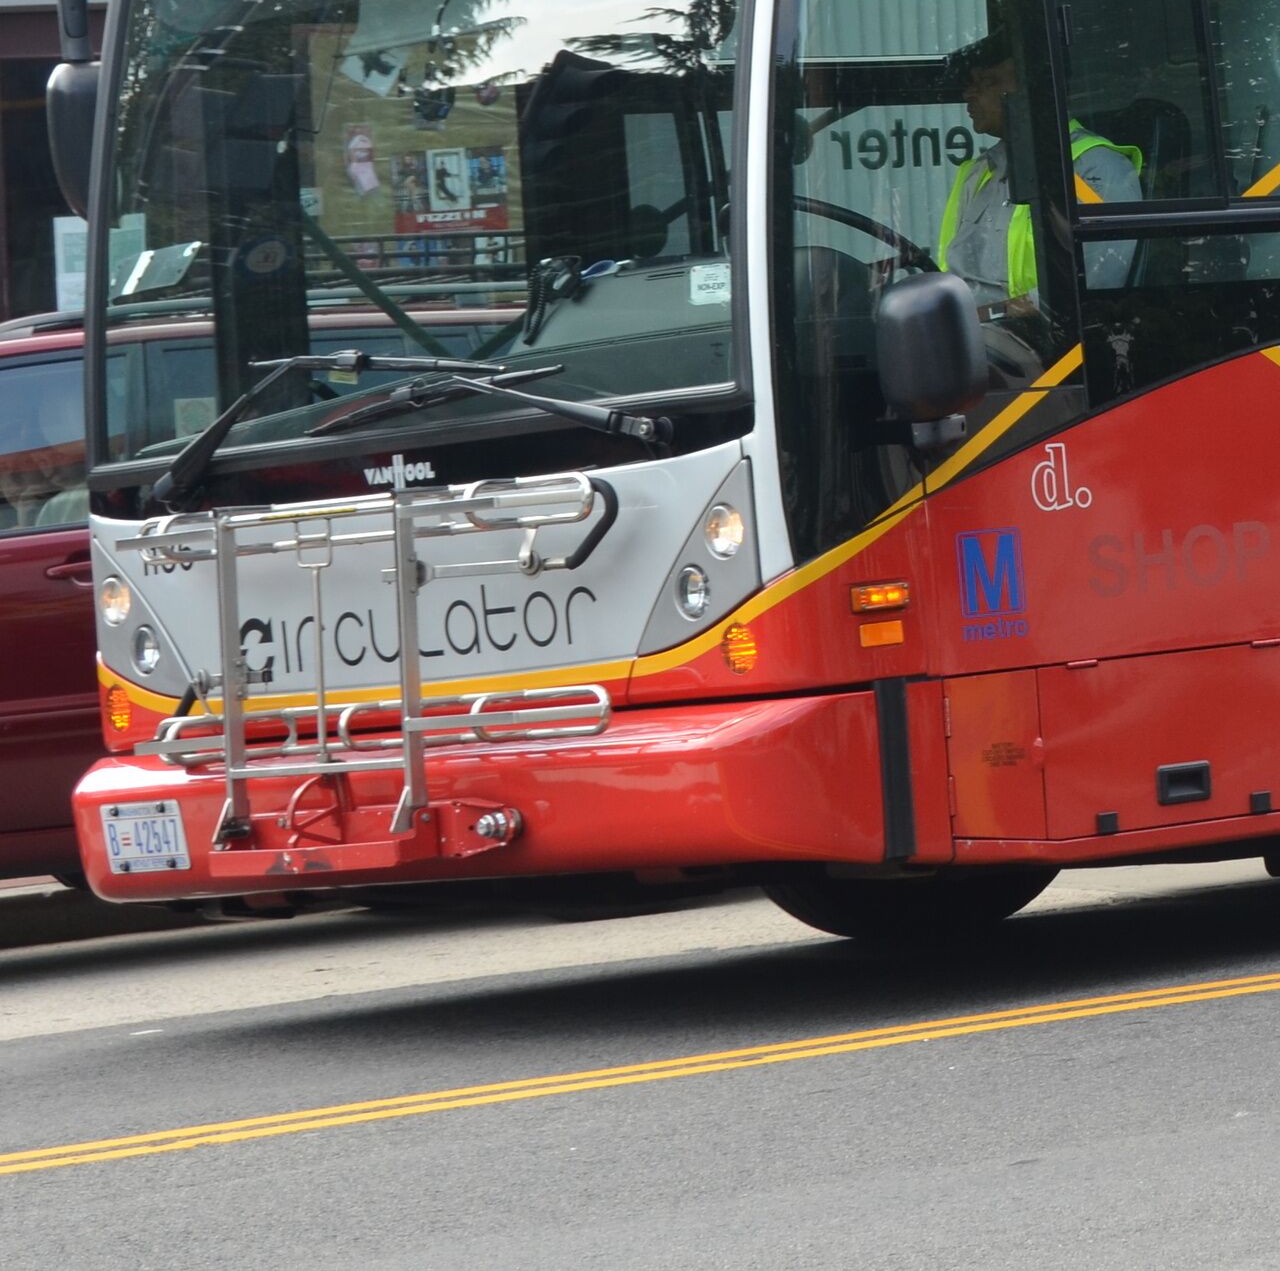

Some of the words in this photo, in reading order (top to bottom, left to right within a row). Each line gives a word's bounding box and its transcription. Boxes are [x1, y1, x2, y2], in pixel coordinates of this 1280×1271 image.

[963, 534, 1019, 612] M
[1087, 520, 1271, 597] SHOP
[963, 618, 1028, 642] metro
